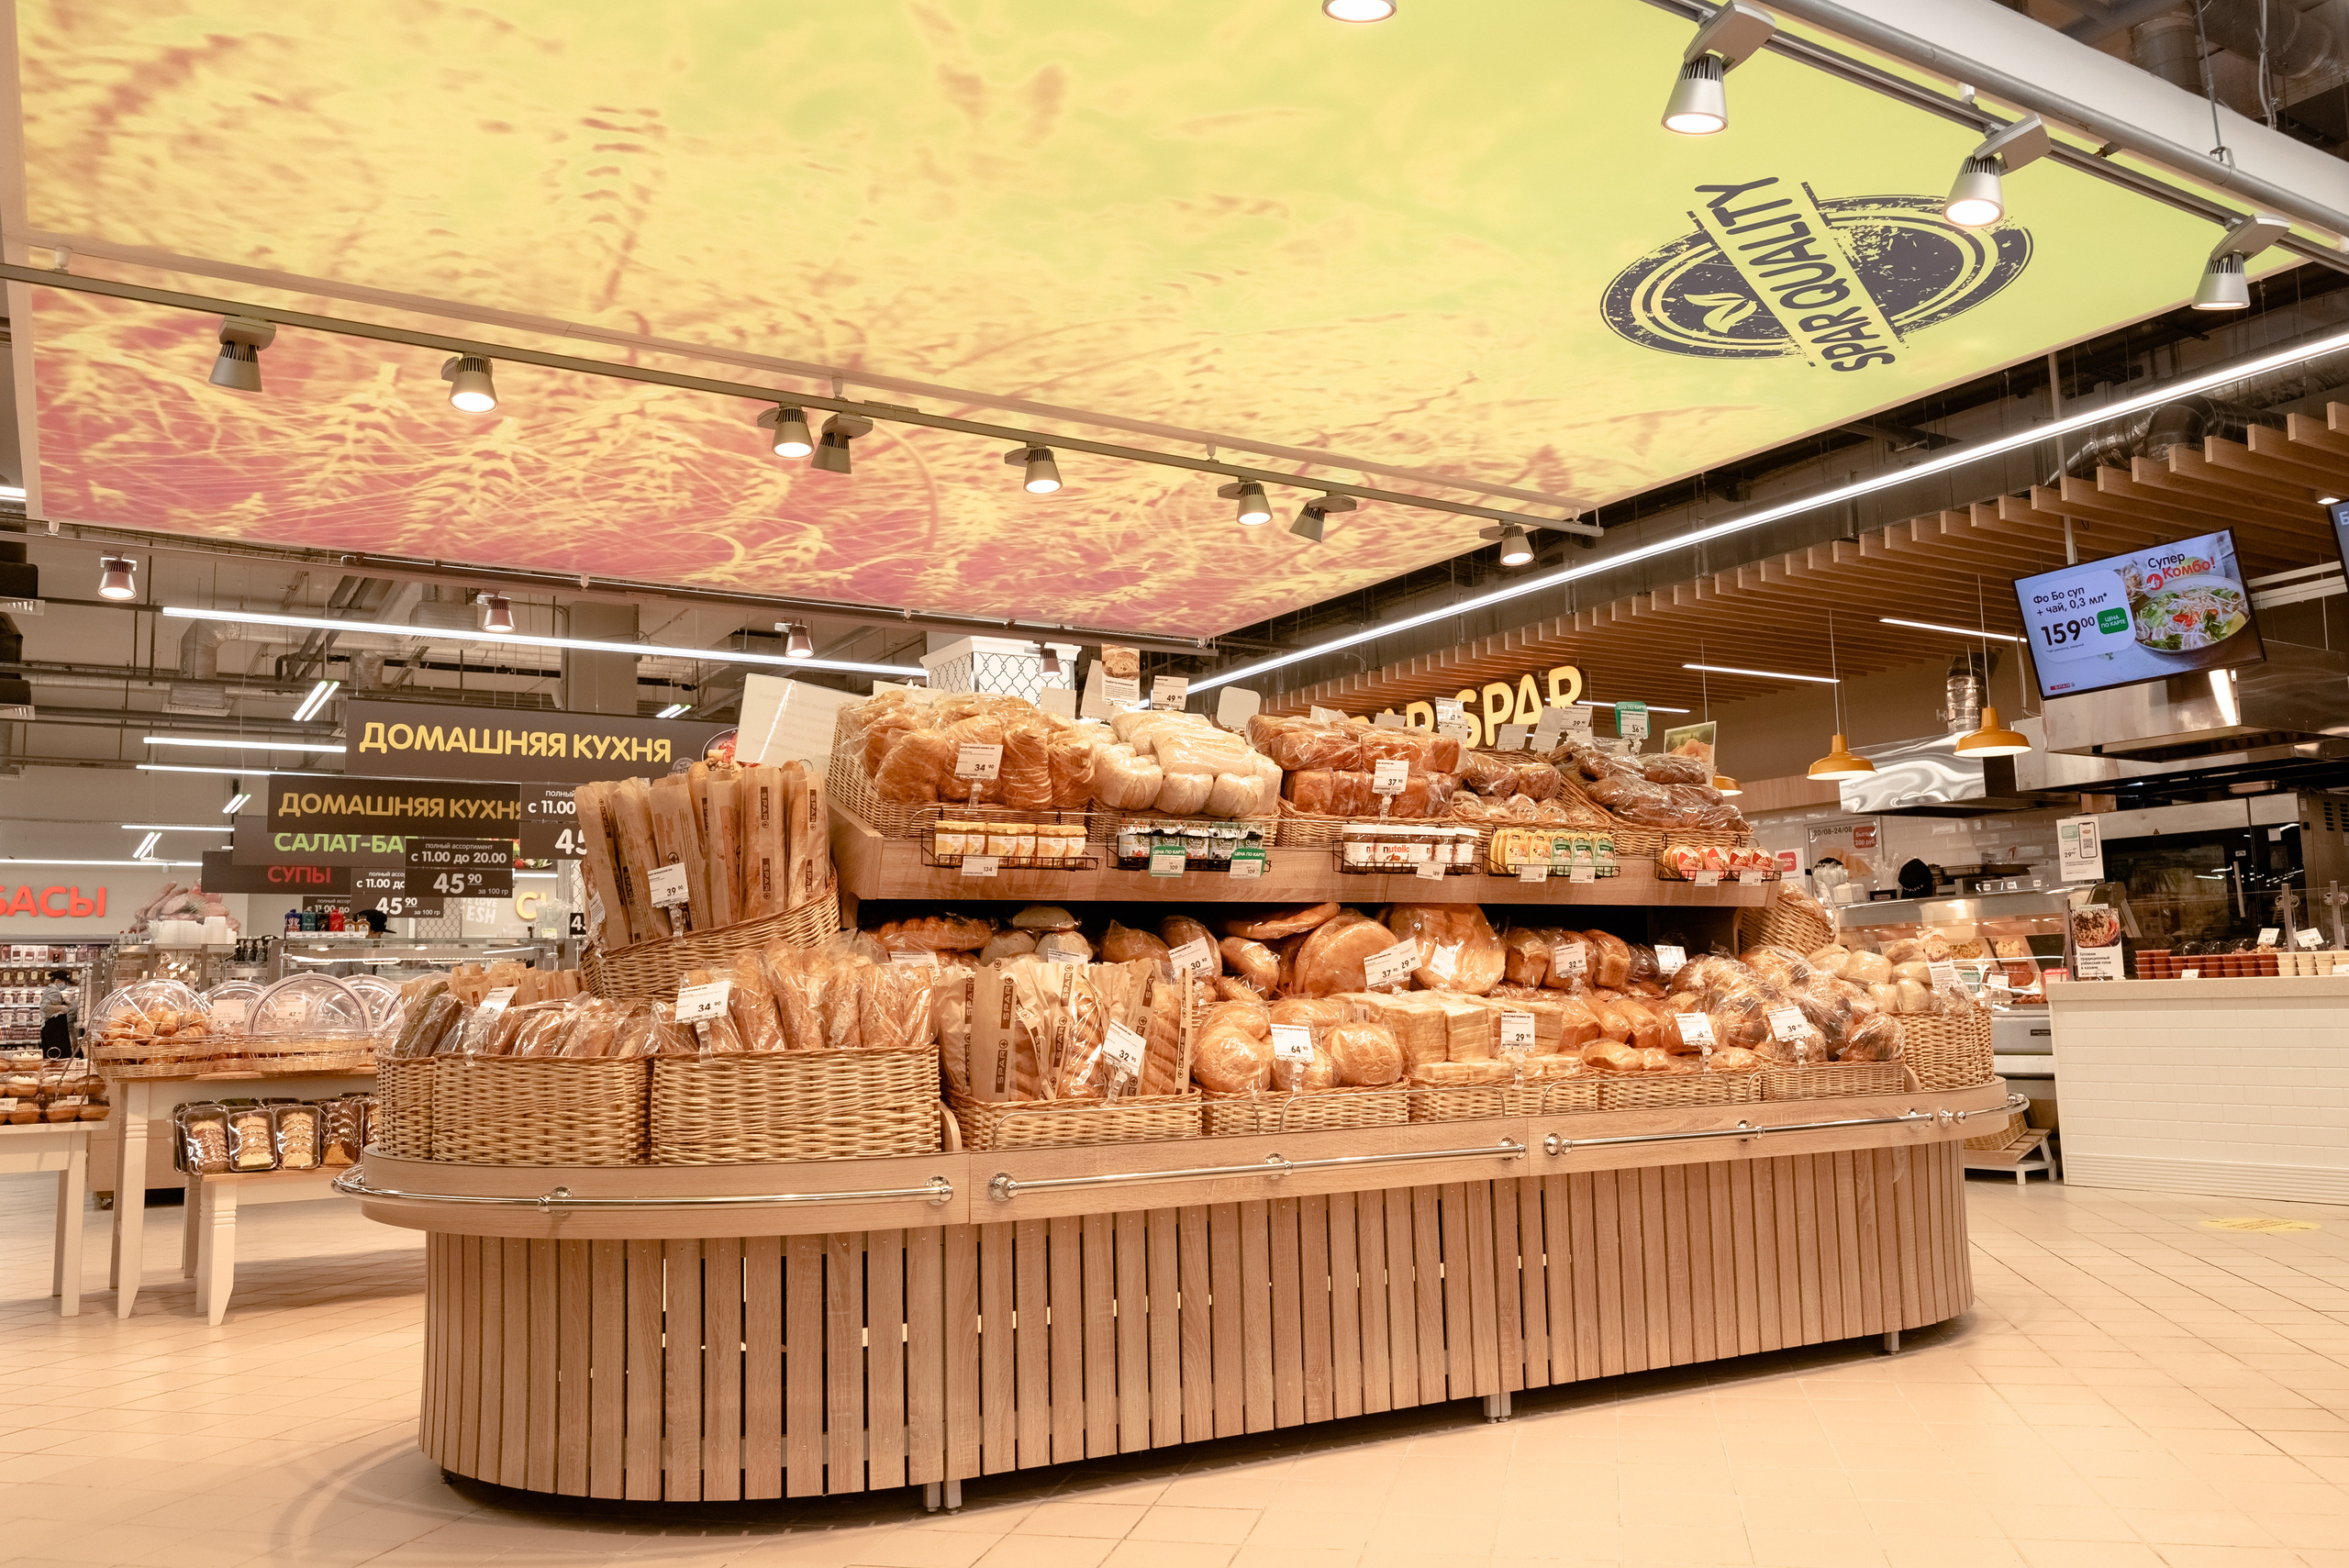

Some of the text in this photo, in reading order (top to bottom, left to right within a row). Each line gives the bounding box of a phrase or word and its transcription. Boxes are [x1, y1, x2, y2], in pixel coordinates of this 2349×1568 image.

[1694, 177, 1895, 373] SPAR QUALITY
[2147, 552, 2186, 571] Супер
[2162, 556, 2216, 580] Комбо!
[2033, 586, 2085, 605] Фо Бо суп
[2045, 602, 2067, 614] чай,
[2069, 597, 2086, 610] 0,3
[2110, 618, 2126, 627] КАРТЕ
[359, 721, 671, 763] ДОМАШНЯЯ КУХНЯ
[278, 793, 444, 817] ДОМАШНЯЯ
[273, 833, 418, 854] САЛАТ-БА
[1383, 844, 1410, 853] nutella
[411, 851, 507, 864] с 11.00 до 20.00
[267, 866, 331, 884] СУПЫ
[356, 880, 363, 888] с
[365, 878, 390, 888] 11.00
[433, 873, 482, 894] 45 90
[624, 872, 633, 897] SPAR
[666, 887, 676, 896] 39
[375, 897, 417, 915] 45 90
[1190, 960, 1201, 971] 30
[1382, 969, 1391, 978] 37
[1401, 960, 1409, 969] 29
[1062, 973, 1073, 999] SPAR
[697, 1003, 711, 1012] 34
[1003, 986, 1012, 1020] SPAR
[1055, 1027, 1065, 1060] SPAR
[1516, 1033, 1525, 1041] 29
[1119, 1050, 1130, 1062] 32
[1291, 1045, 1301, 1053] 64
[997, 1051, 1007, 1084] SPAR
